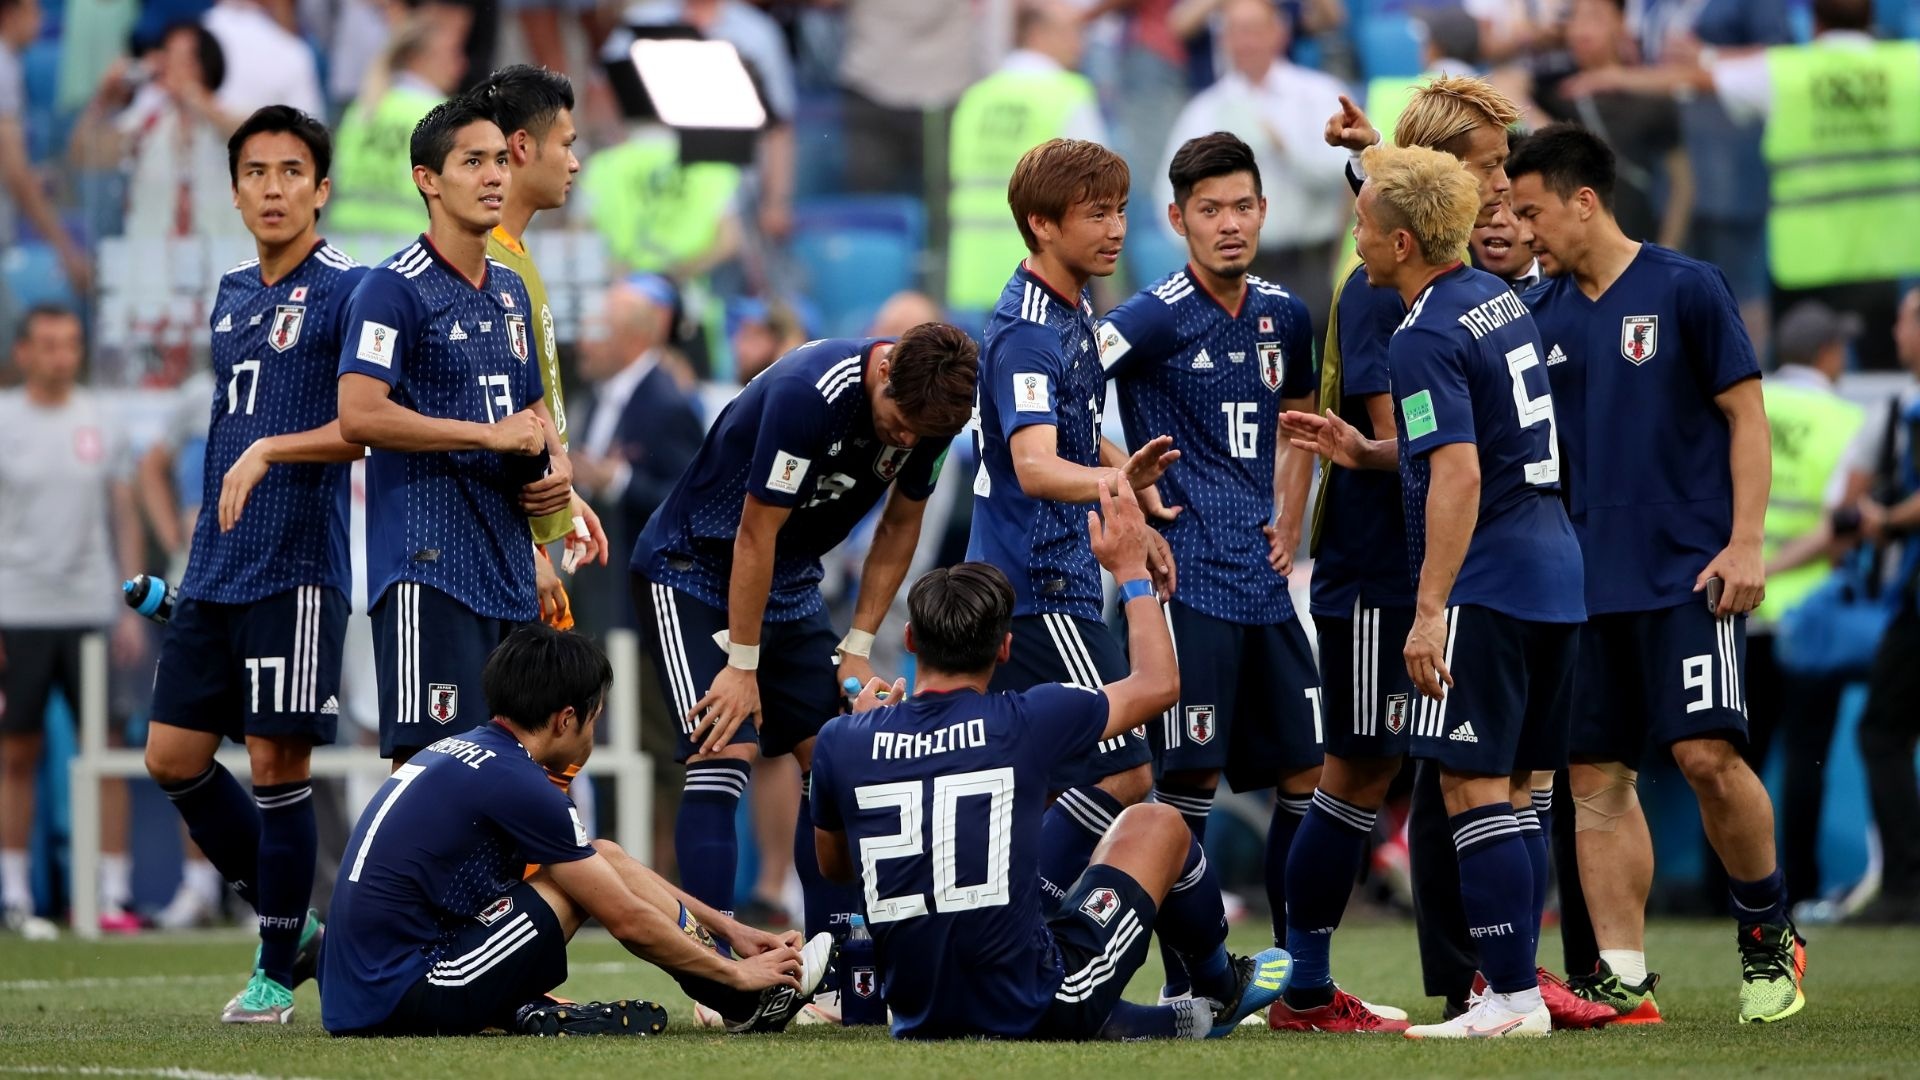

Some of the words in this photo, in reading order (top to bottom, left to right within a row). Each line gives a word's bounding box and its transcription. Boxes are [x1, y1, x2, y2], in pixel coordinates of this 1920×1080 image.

[227, 359, 261, 416] 17
[1546, 355, 1568, 367] adidas
[1221, 402, 1259, 459] 16
[1504, 342, 1560, 485] 5
[245, 656, 286, 714] 17
[1682, 653, 1713, 714] 9
[871, 718, 986, 760] MAKINO
[1448, 732, 1479, 744] adidas
[348, 762, 428, 882] 7
[854, 766, 1015, 925] 20
